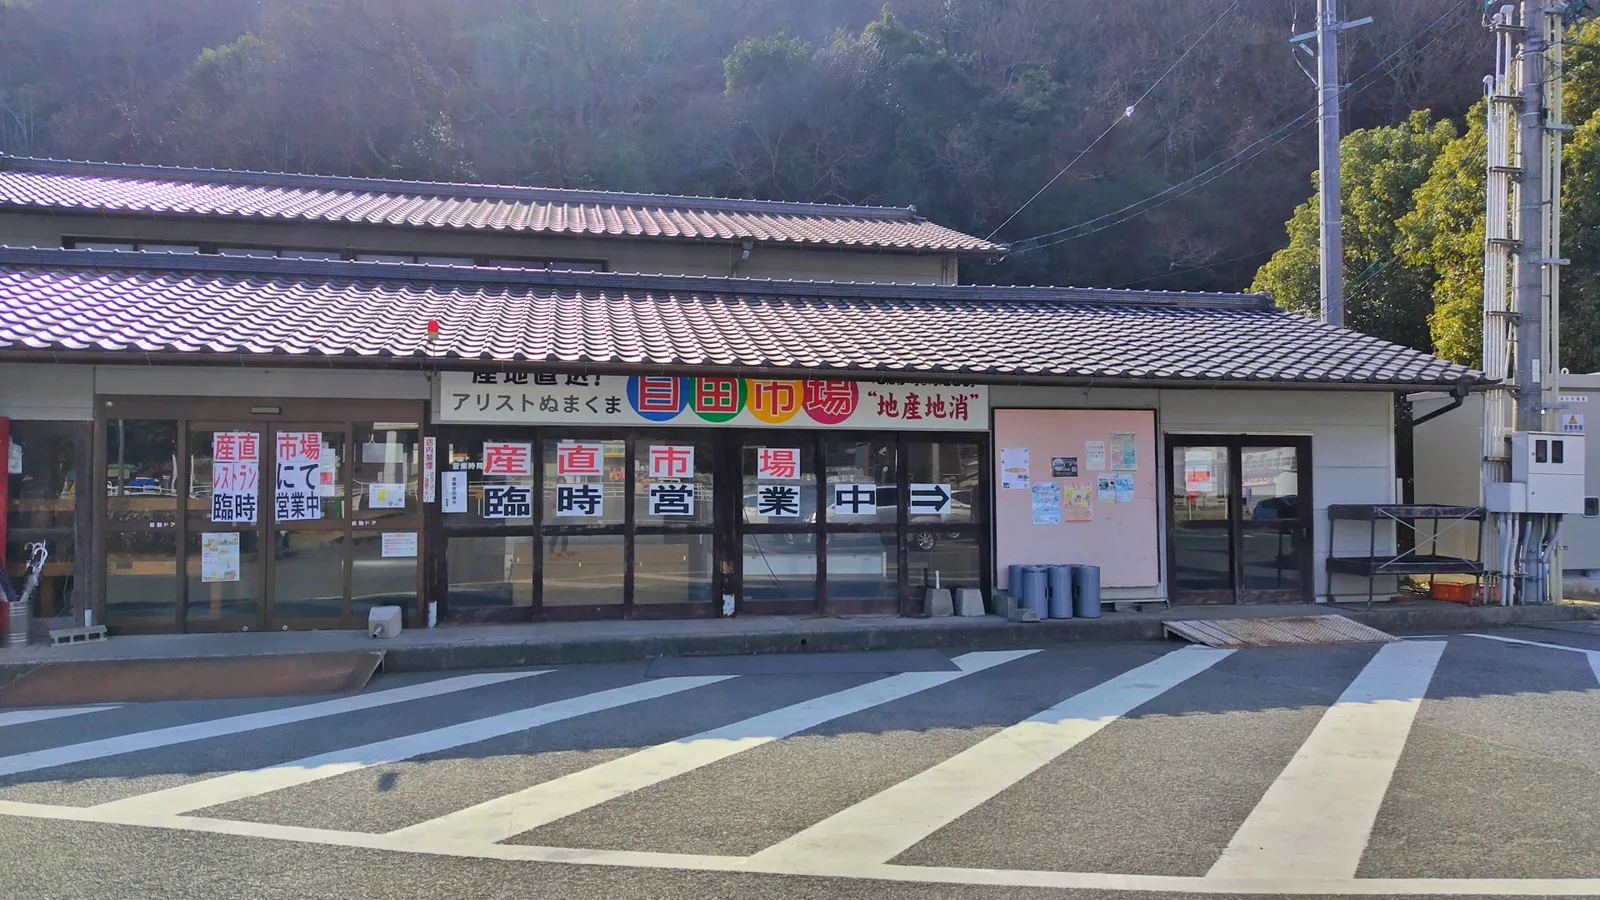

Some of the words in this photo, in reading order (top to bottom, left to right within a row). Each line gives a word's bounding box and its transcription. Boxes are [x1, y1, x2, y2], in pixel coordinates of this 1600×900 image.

[452, 393, 622, 414] アリストぬまくま
[215, 432, 258, 461] 産直
[278, 432, 321, 461] 市場
[425, 438, 434, 470] 店内禁煙
[213, 463, 257, 491] レストラン
[276, 463, 319, 490] にて
[212, 493, 257, 521] 臨時
[276, 490, 320, 520] 営業中
